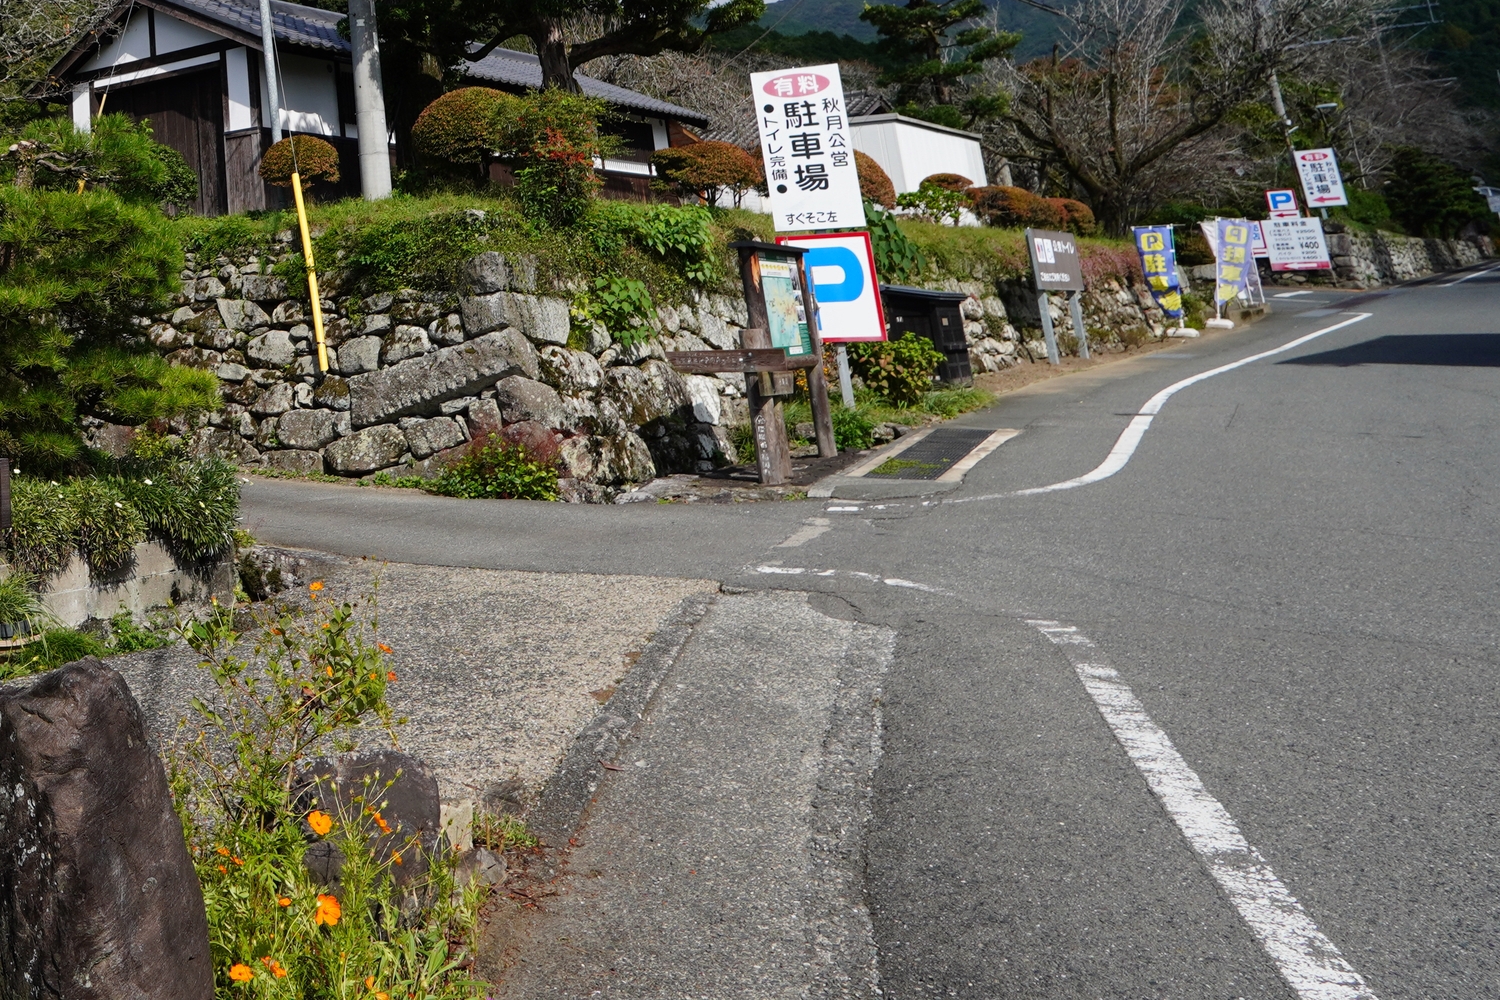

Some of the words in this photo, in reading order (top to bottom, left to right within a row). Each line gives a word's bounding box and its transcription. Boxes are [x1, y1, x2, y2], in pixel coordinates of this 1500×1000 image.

[773, 74, 819, 97] 有料
[784, 100, 830, 192] 駐車場
[821, 97, 849, 168] 秋月公営
[763, 116, 788, 181] トイレ完備
[1309, 162, 1331, 194] 駐車場
[1270, 193, 1292, 209] P
[786, 211, 838, 226] すぐそこ左
[1300, 241, 1319, 249] ¥400
